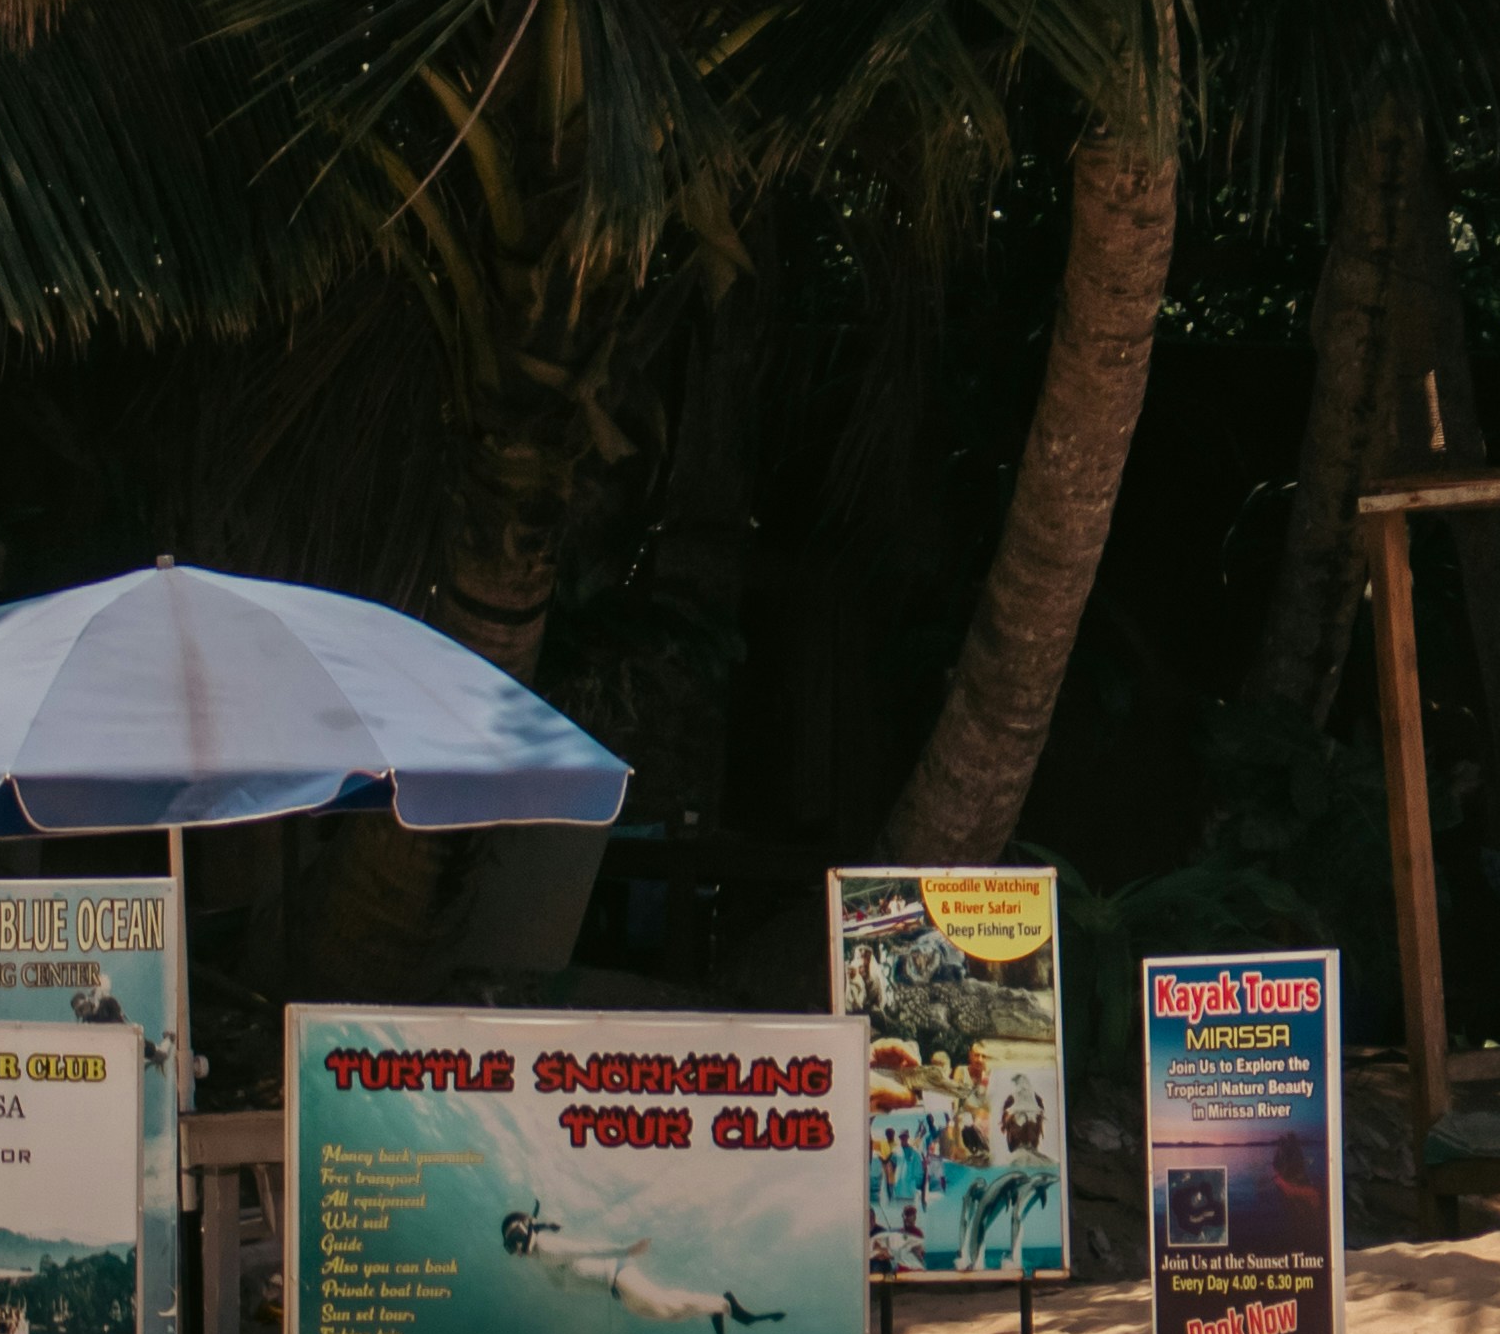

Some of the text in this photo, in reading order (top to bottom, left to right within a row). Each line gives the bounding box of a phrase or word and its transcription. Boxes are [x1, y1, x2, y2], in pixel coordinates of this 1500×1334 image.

[925, 878, 1040, 895] Crocodile Watching
[942, 900, 1021, 914] & River Safari
[76, 897, 165, 952] OCEAN
[947, 922, 1041, 939] Deep Fishing Tour
[21, 961, 102, 987] CENTER
[1155, 971, 1321, 1024] Kayak Tours
[1187, 1024, 1290, 1049] MIRISSA
[26, 1055, 106, 1081] CLUB
[324, 1047, 833, 1096] TURTLE SNORKELING
[1166, 1080, 1313, 1101] Tropical Nature Beauty
[559, 1105, 834, 1150] TOUR CLUB
[321, 1233, 363, 1256] Guide
[1172, 1275, 1204, 1294] Every
[1208, 1275, 1229, 1294] Day
[1232, 1276, 1257, 1289] 4.00
[1268, 1274, 1291, 1288] 6.30
[1295, 1276, 1313, 1293] pm
